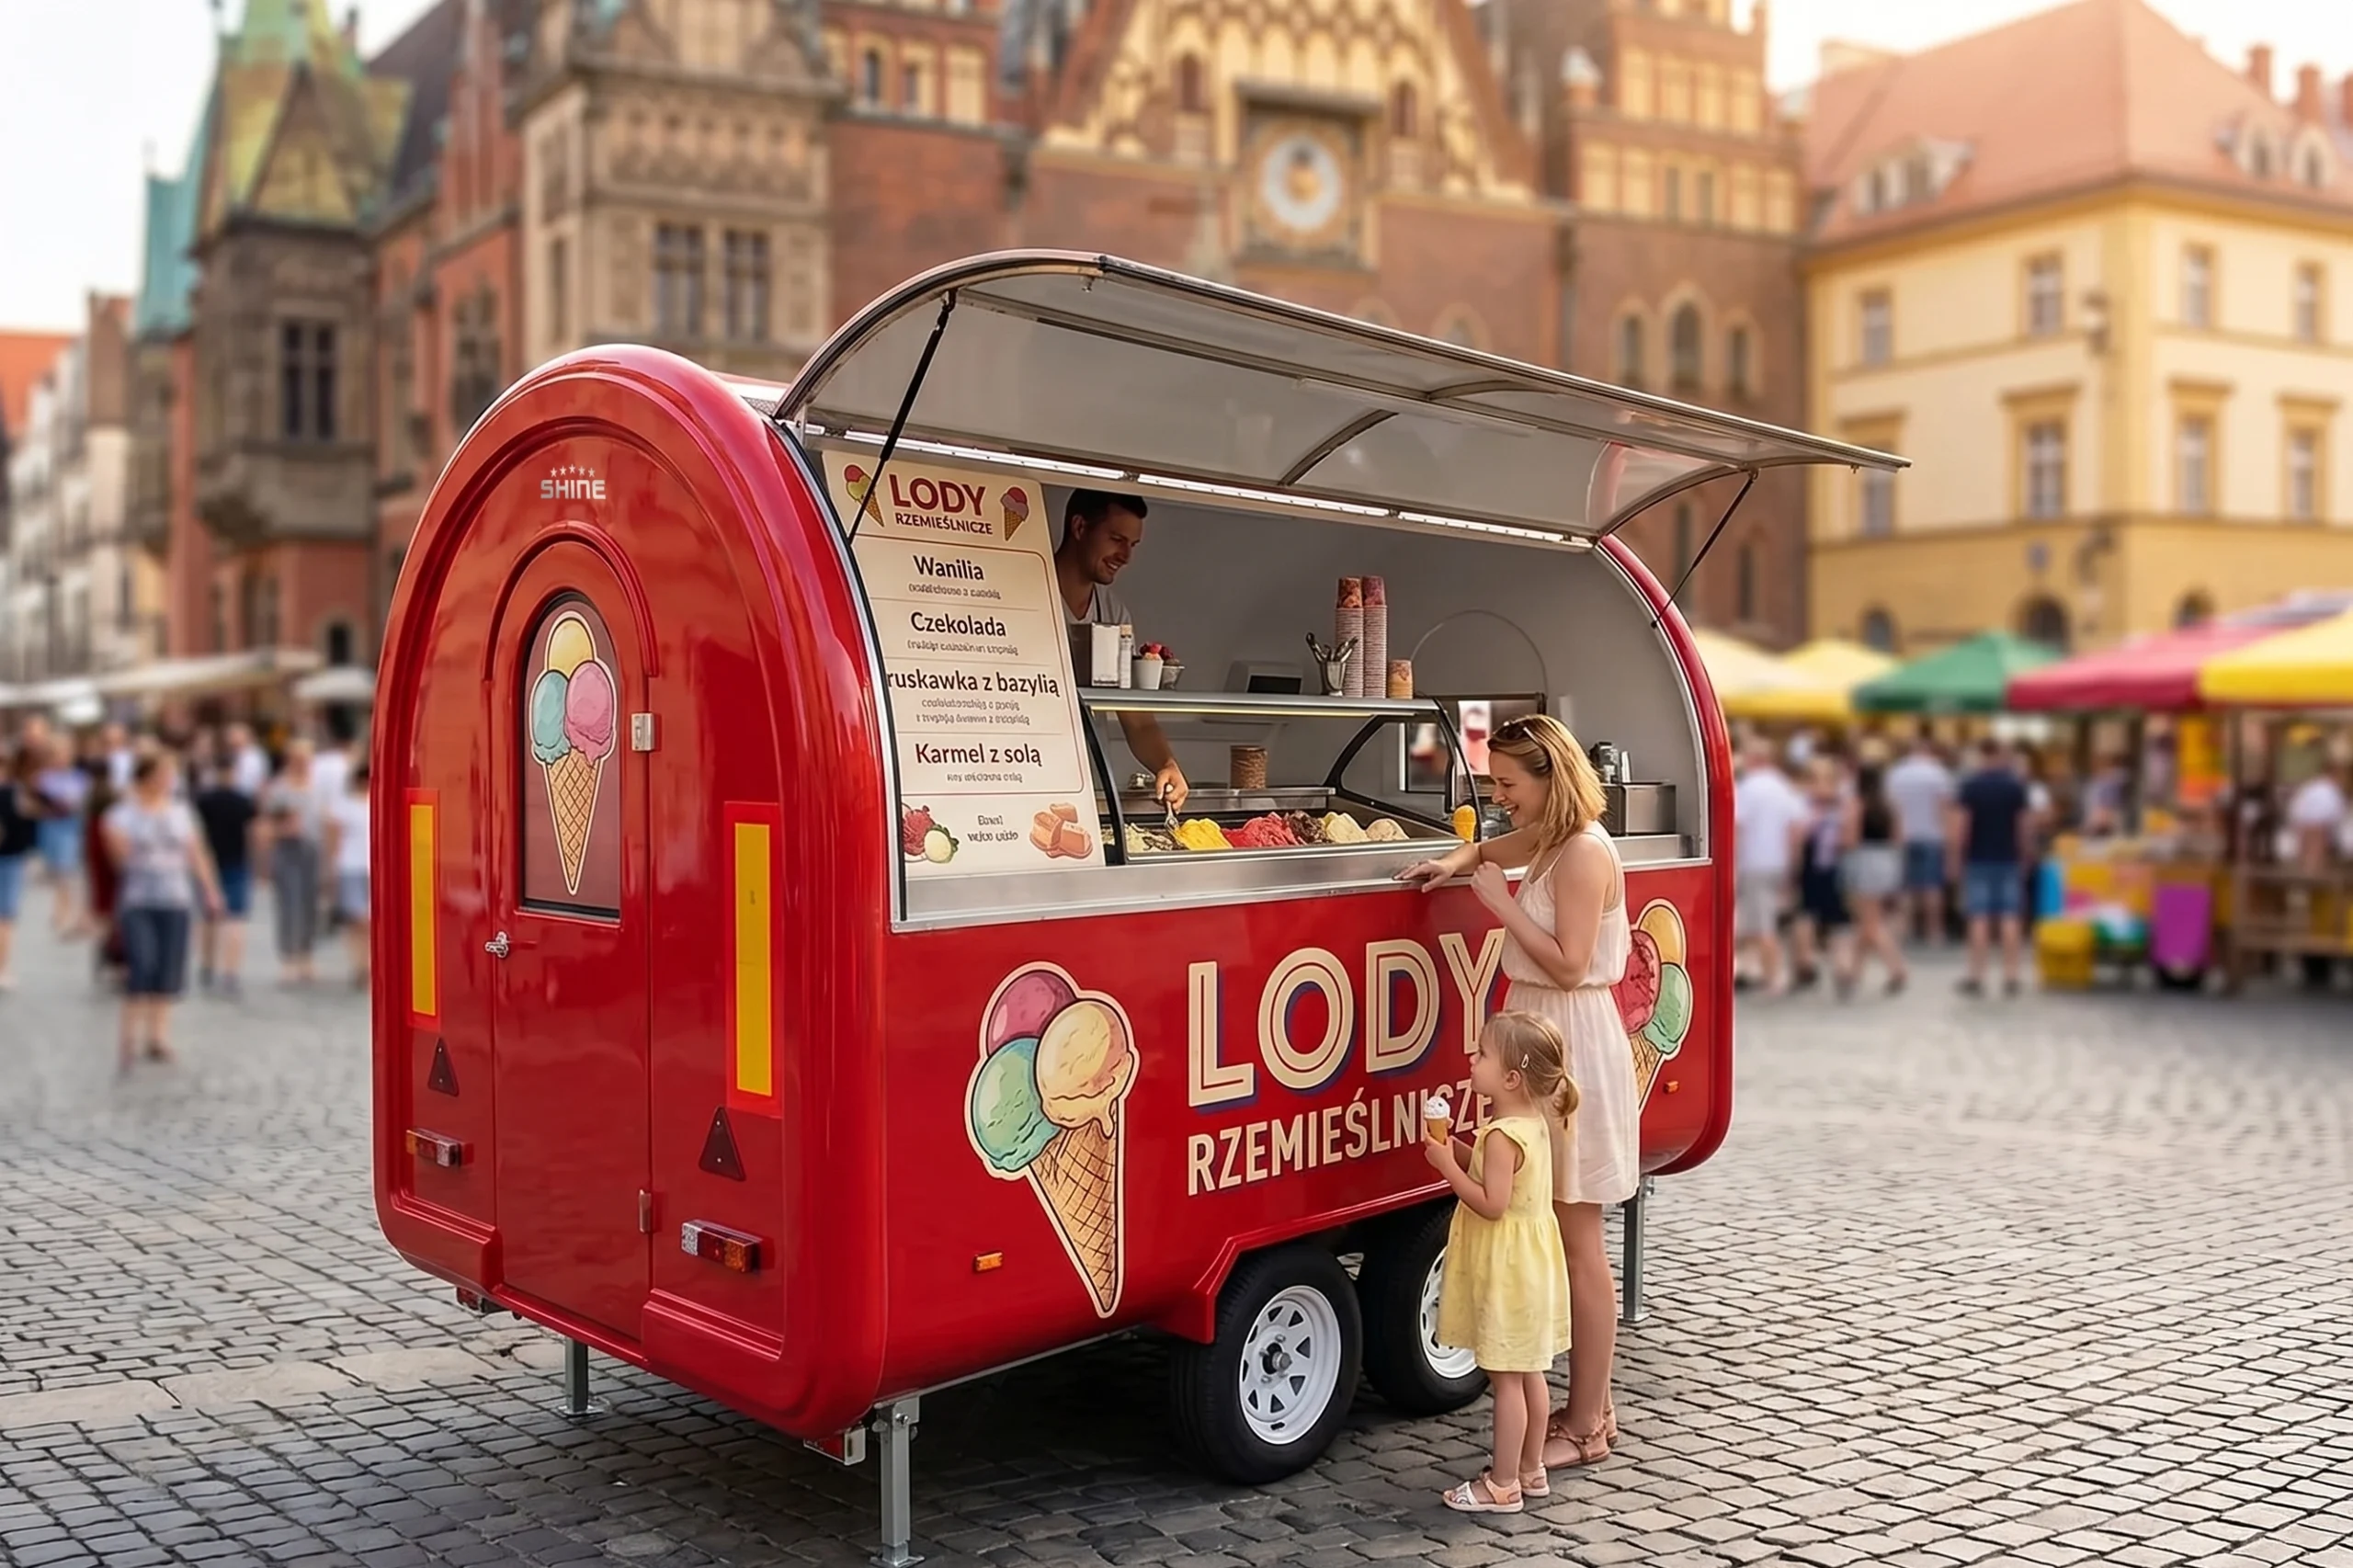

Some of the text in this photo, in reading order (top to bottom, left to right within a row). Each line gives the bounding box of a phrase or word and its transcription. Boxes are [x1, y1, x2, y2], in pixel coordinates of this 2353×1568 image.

[540, 479, 606, 500] SHINE
[889, 473, 986, 517] LODY
[895, 512, 993, 535] RZEMIEŚLNICZE
[913, 555, 984, 581] Wanilia
[910, 611, 1006, 637] Czekolada
[887, 668, 1060, 698] ruskawka z bazylią
[915, 743, 1042, 767] Karmel z solą
[1188, 927, 1506, 1108] LODY
